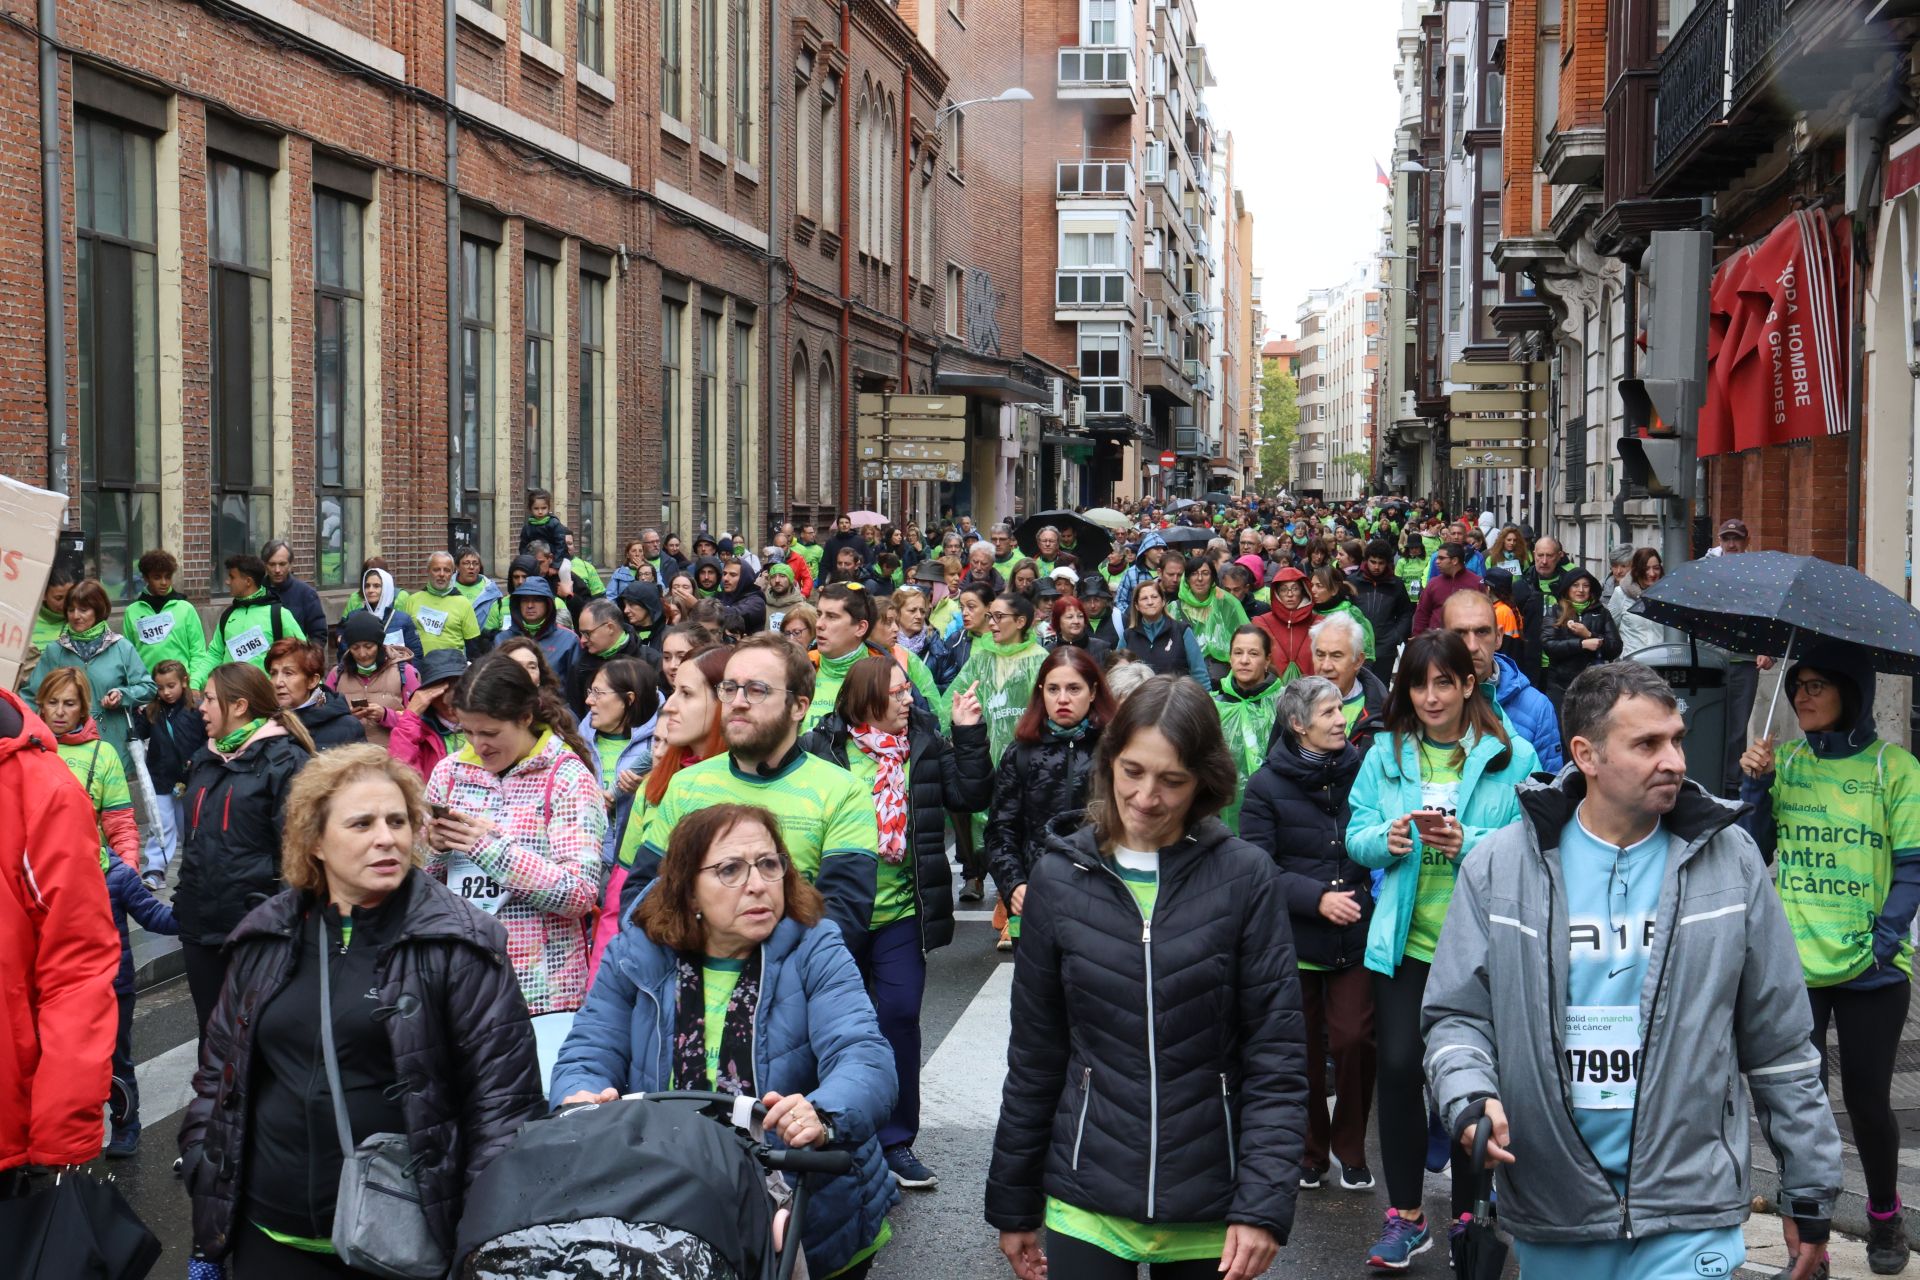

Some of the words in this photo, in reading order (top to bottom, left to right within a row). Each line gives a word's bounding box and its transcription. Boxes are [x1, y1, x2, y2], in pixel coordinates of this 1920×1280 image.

[1768, 331, 1786, 424] GRANDES
[1788, 324, 1811, 407] HOMBRE
[235, 637, 262, 656] 53165
[1796, 823, 1883, 850] marcha
[1790, 872, 1870, 898] cáncer
[1600, 1014, 1633, 1023] marcha
